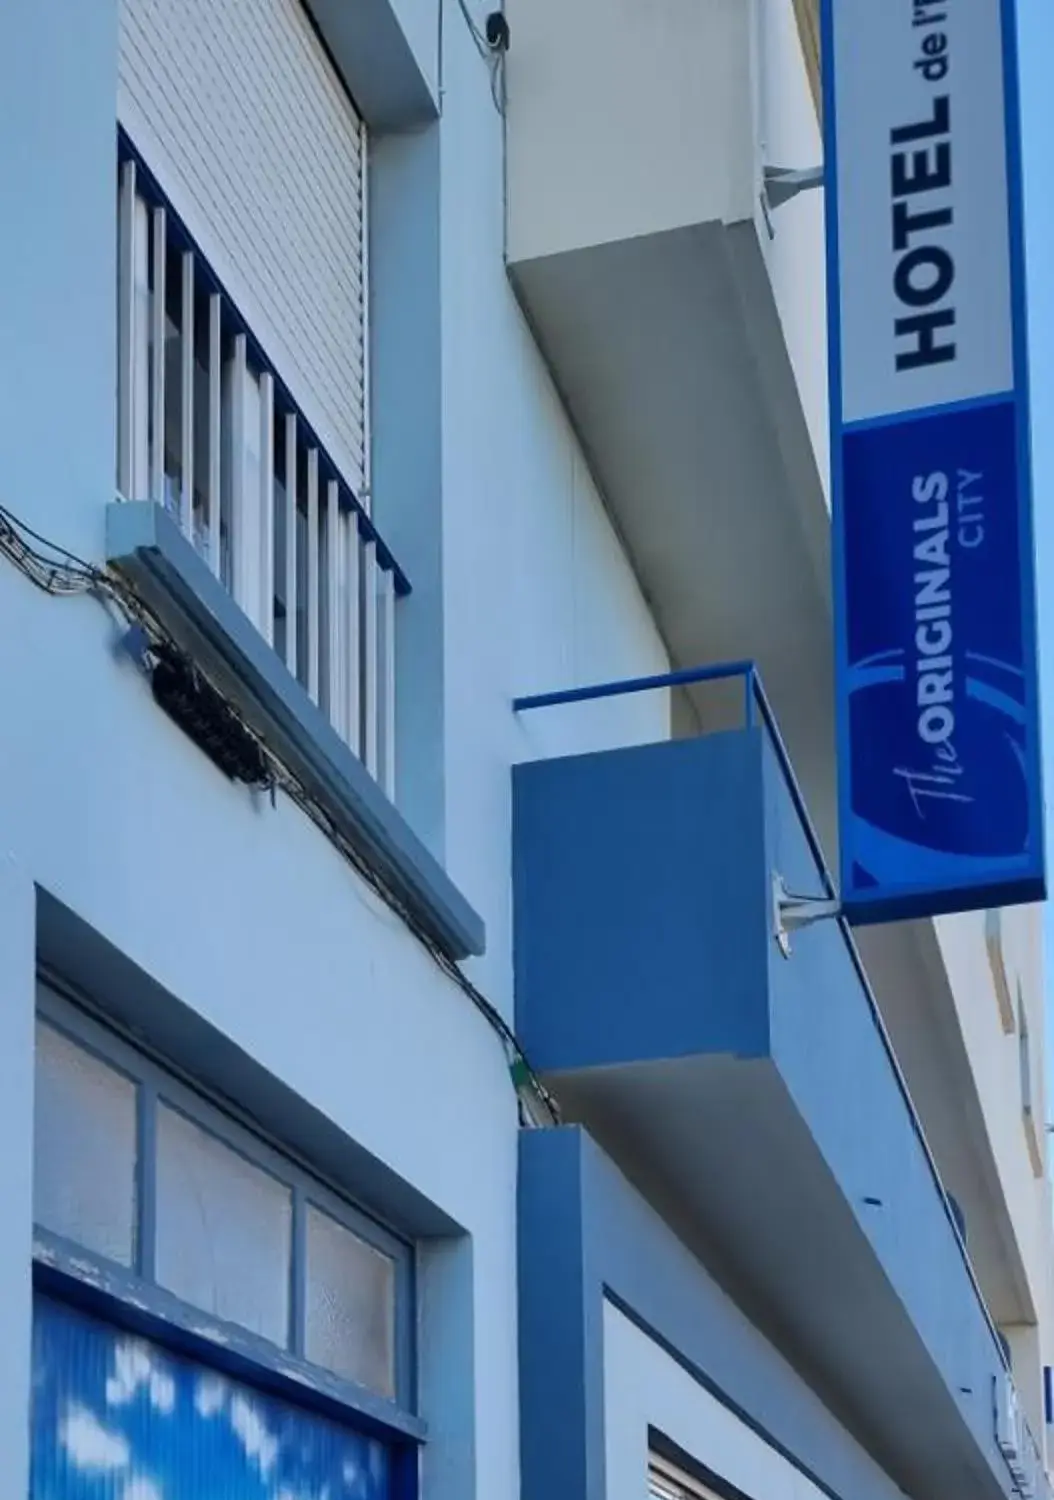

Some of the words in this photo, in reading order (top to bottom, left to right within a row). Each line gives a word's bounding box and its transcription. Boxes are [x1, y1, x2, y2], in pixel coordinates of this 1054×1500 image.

[912, 32, 948, 82] de
[890, 95, 956, 372] HOTEL
[957, 468, 985, 548] CITY
[912, 471, 955, 743] ORIGINALS
[893, 740, 975, 819] The
